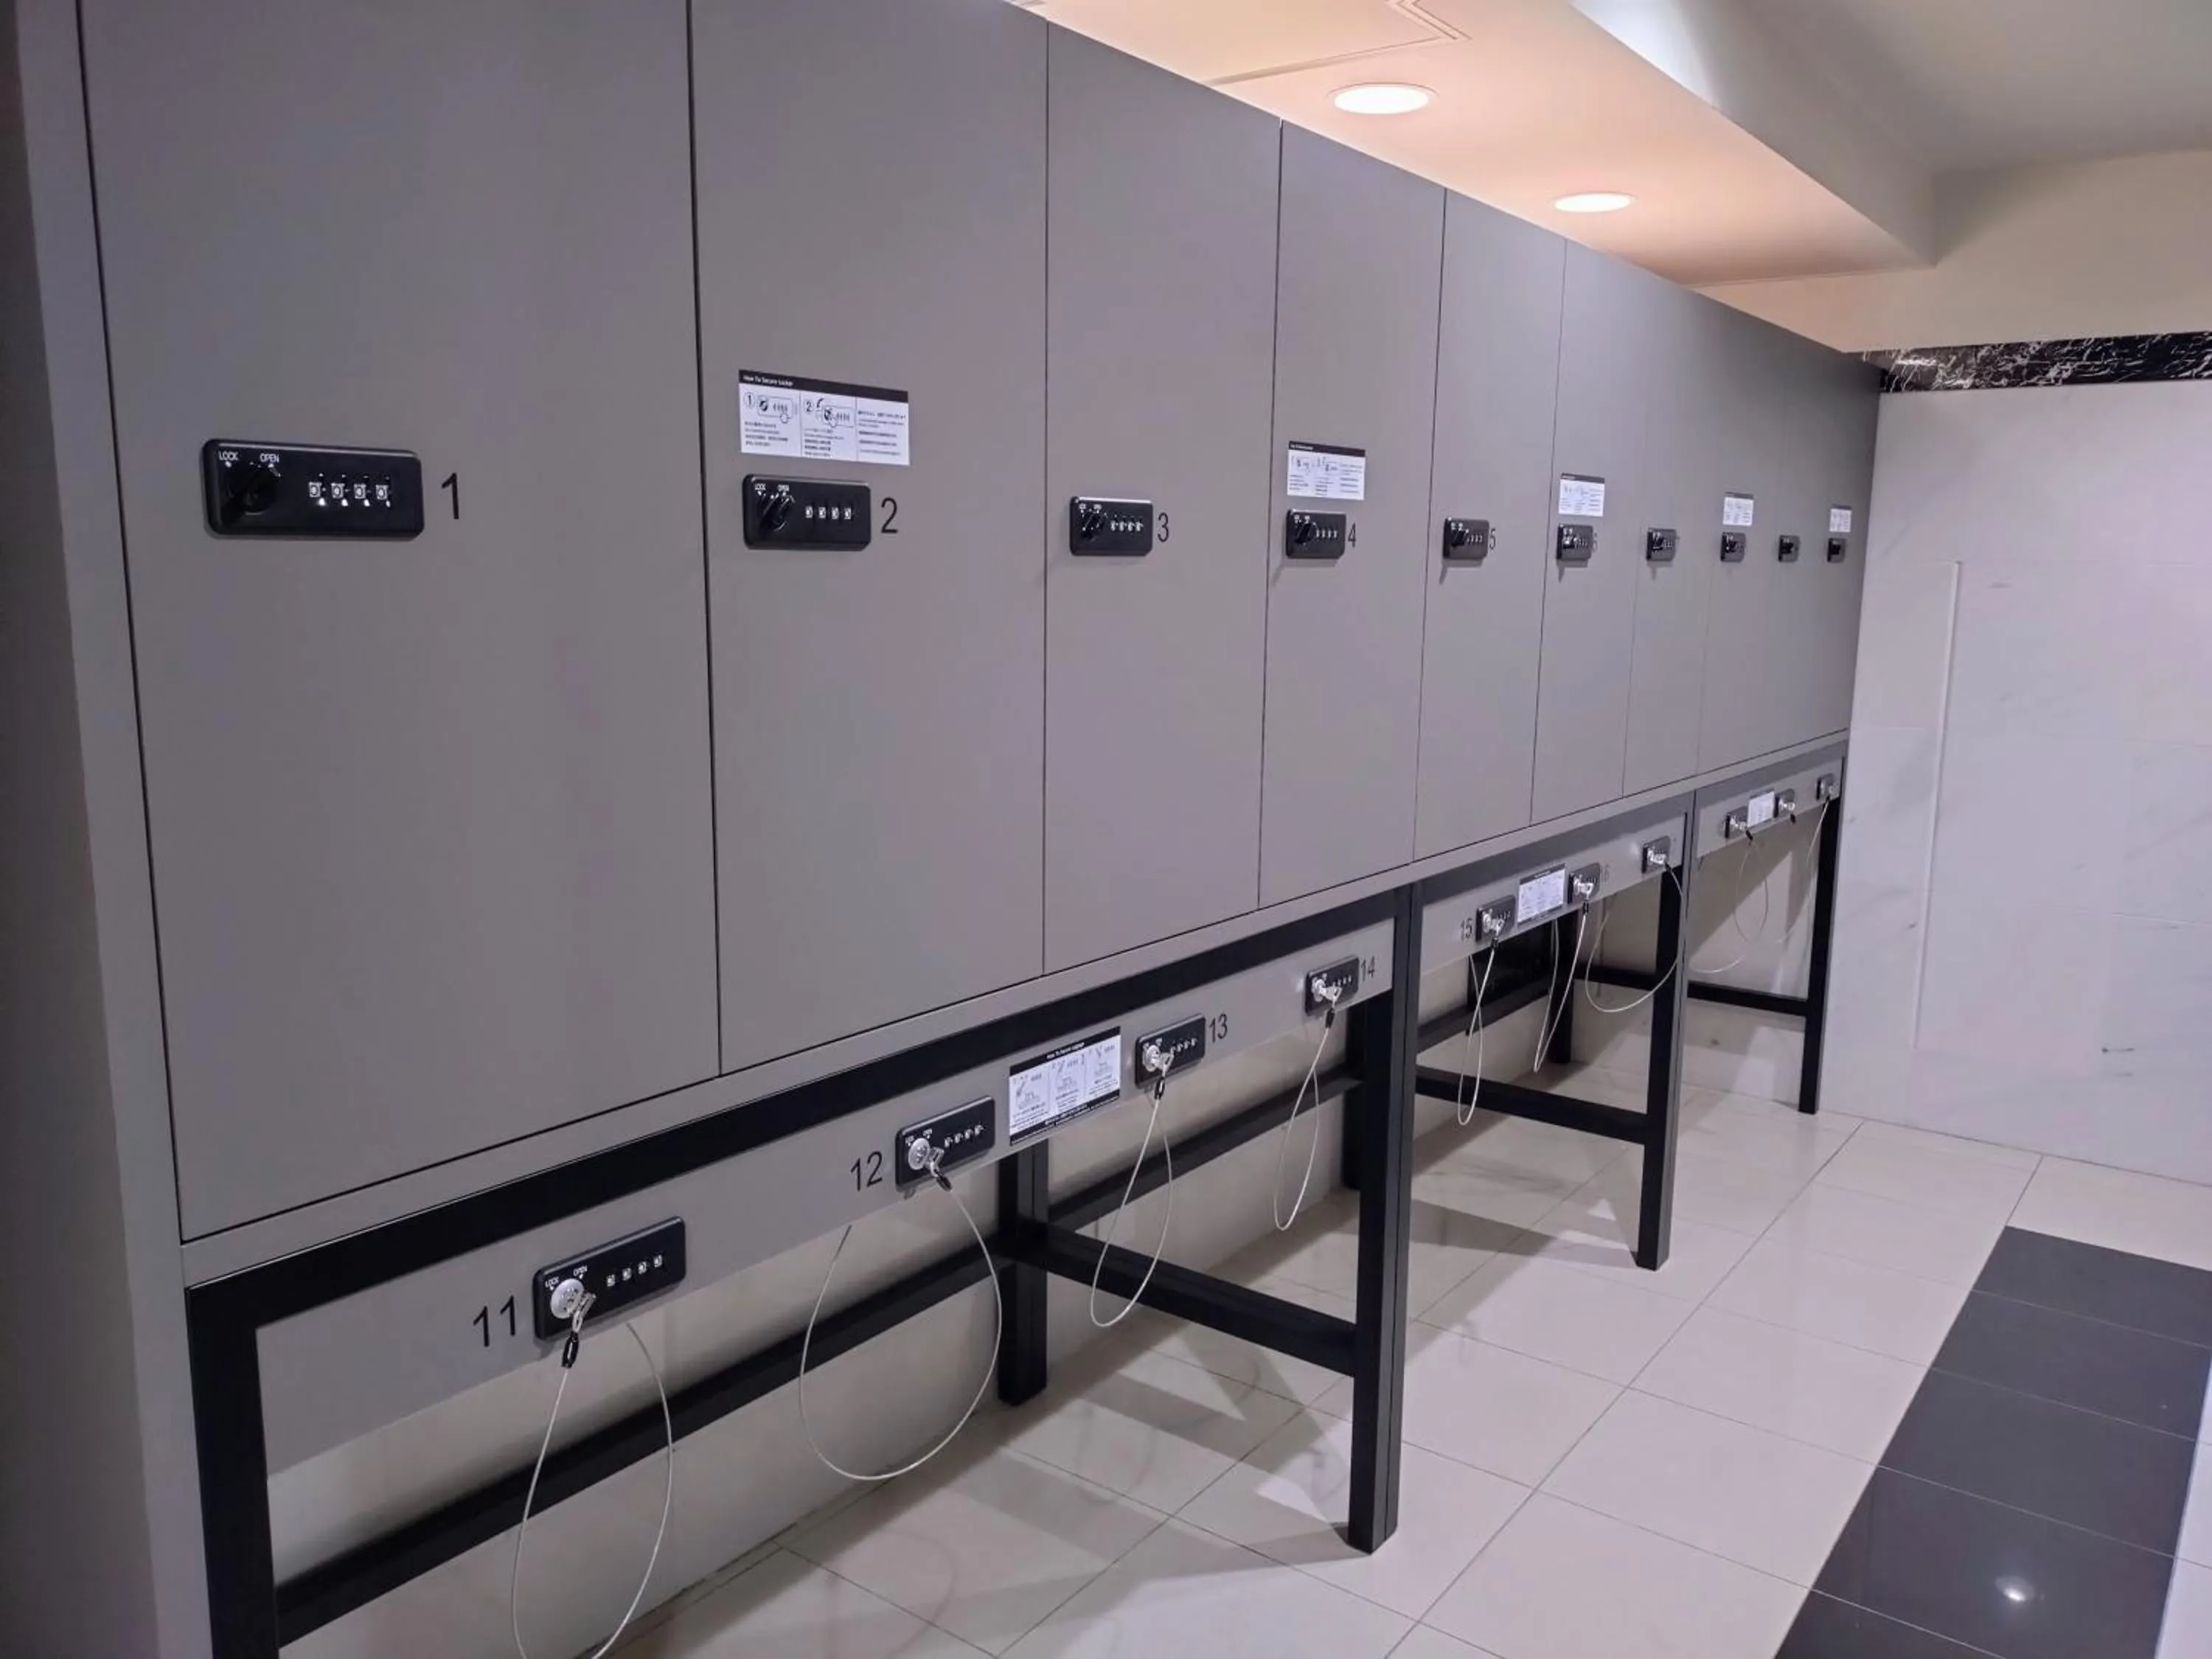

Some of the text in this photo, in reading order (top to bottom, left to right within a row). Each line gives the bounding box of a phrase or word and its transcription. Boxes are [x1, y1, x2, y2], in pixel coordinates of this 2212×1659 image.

[218, 451, 279, 463] LOCK OPEN
[441, 473, 460, 520] 1
[880, 497, 899, 534] 2
[1157, 512, 1169, 543] 3
[1348, 523, 1357, 548] 4
[1489, 528, 1496, 551] 5
[1461, 917, 1472, 942] 15
[1360, 956, 1375, 982] 14
[1209, 1014, 1228, 1044] 13
[850, 1151, 883, 1192] 12
[473, 1294, 516, 1347] 11
